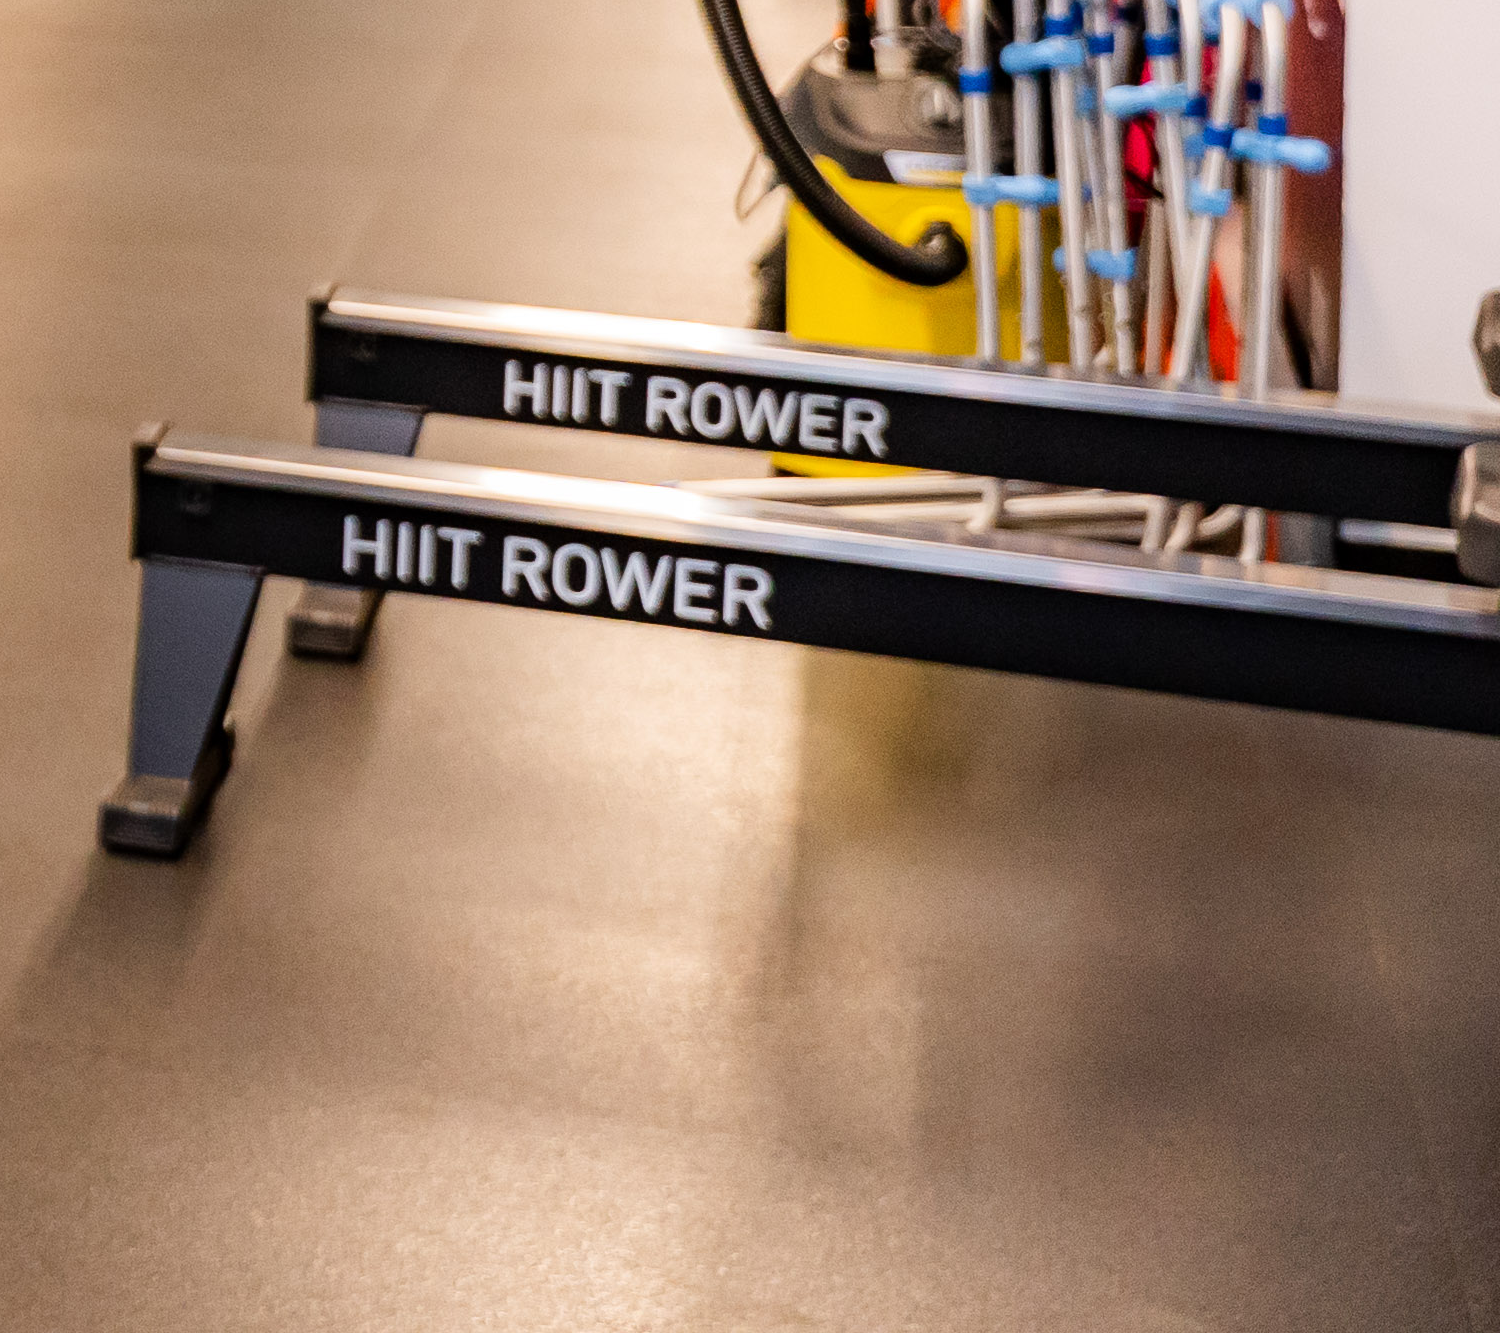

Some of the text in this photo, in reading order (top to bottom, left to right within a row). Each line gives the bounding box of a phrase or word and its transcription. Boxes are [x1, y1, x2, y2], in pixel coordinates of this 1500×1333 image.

[503, 358, 890, 459] HIIT ROWER
[342, 513, 774, 631] HIIT ROWER
